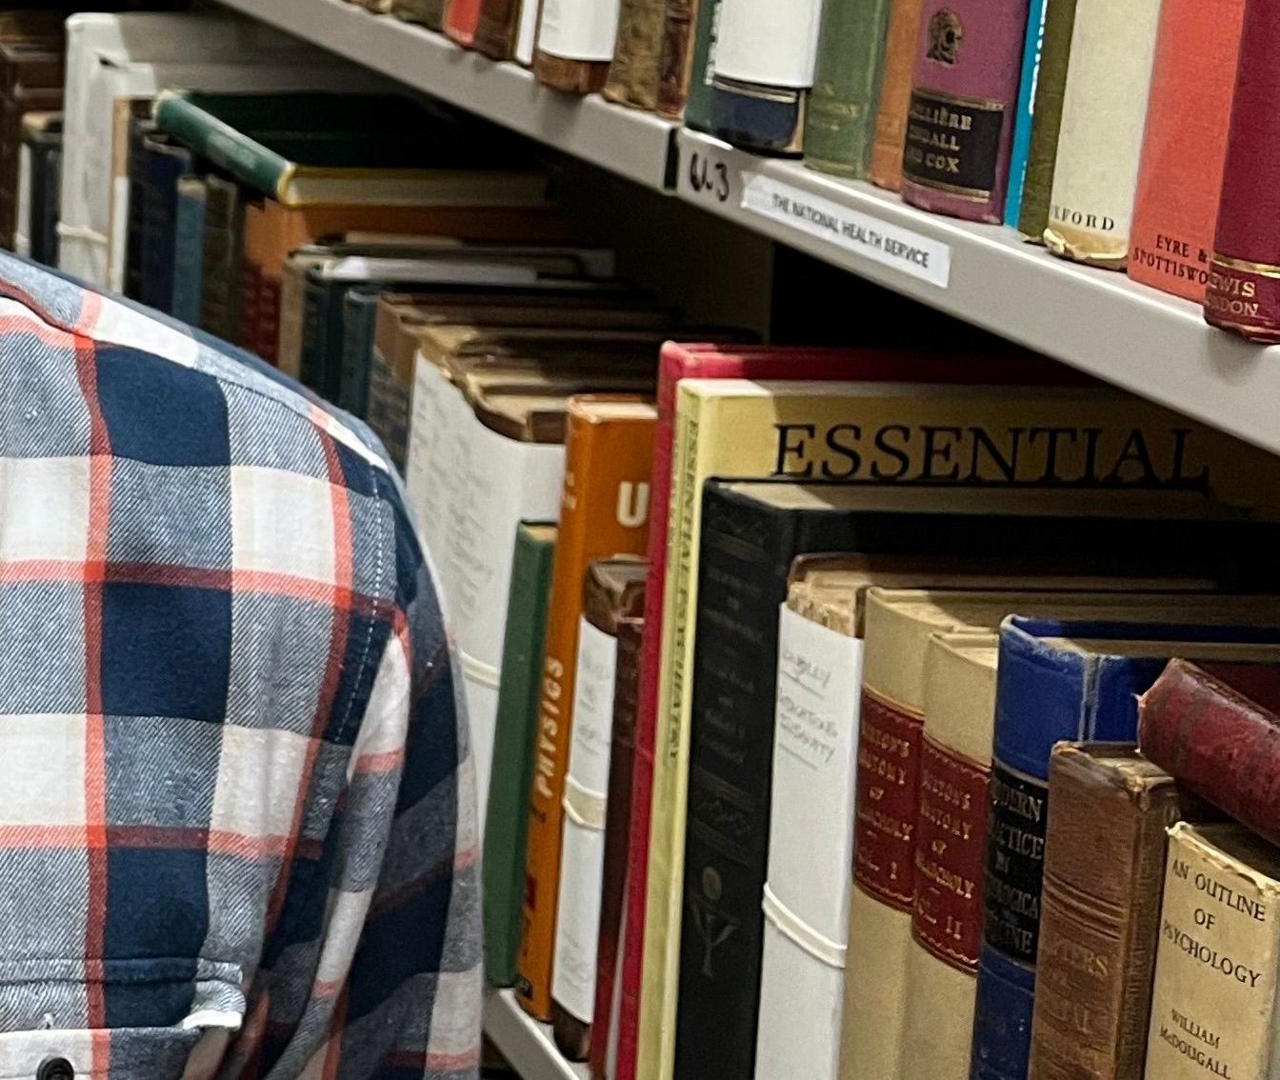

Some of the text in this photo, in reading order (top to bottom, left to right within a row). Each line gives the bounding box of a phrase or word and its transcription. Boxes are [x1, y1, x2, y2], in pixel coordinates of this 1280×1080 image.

[925, 152, 959, 173] COX
[771, 193, 930, 270] THE NATIONAL HEALTH SERVICE
[1052, 206, 1115, 231] XFORD
[1132, 247, 1208, 285] SPOTTISWO
[1156, 234, 1190, 258] EYRE
[772, 423, 1210, 493] ESSENTIAL
[534, 657, 564, 798] PHYSICS
[1172, 859, 1266, 922] AN OUTLINE
[1194, 908, 1216, 930] OF
[1164, 920, 1262, 988] PSYCHOLOGY
[1171, 1009, 1221, 1049] WILLIAM
[1160, 1026, 1232, 1080] McDOUGALL
